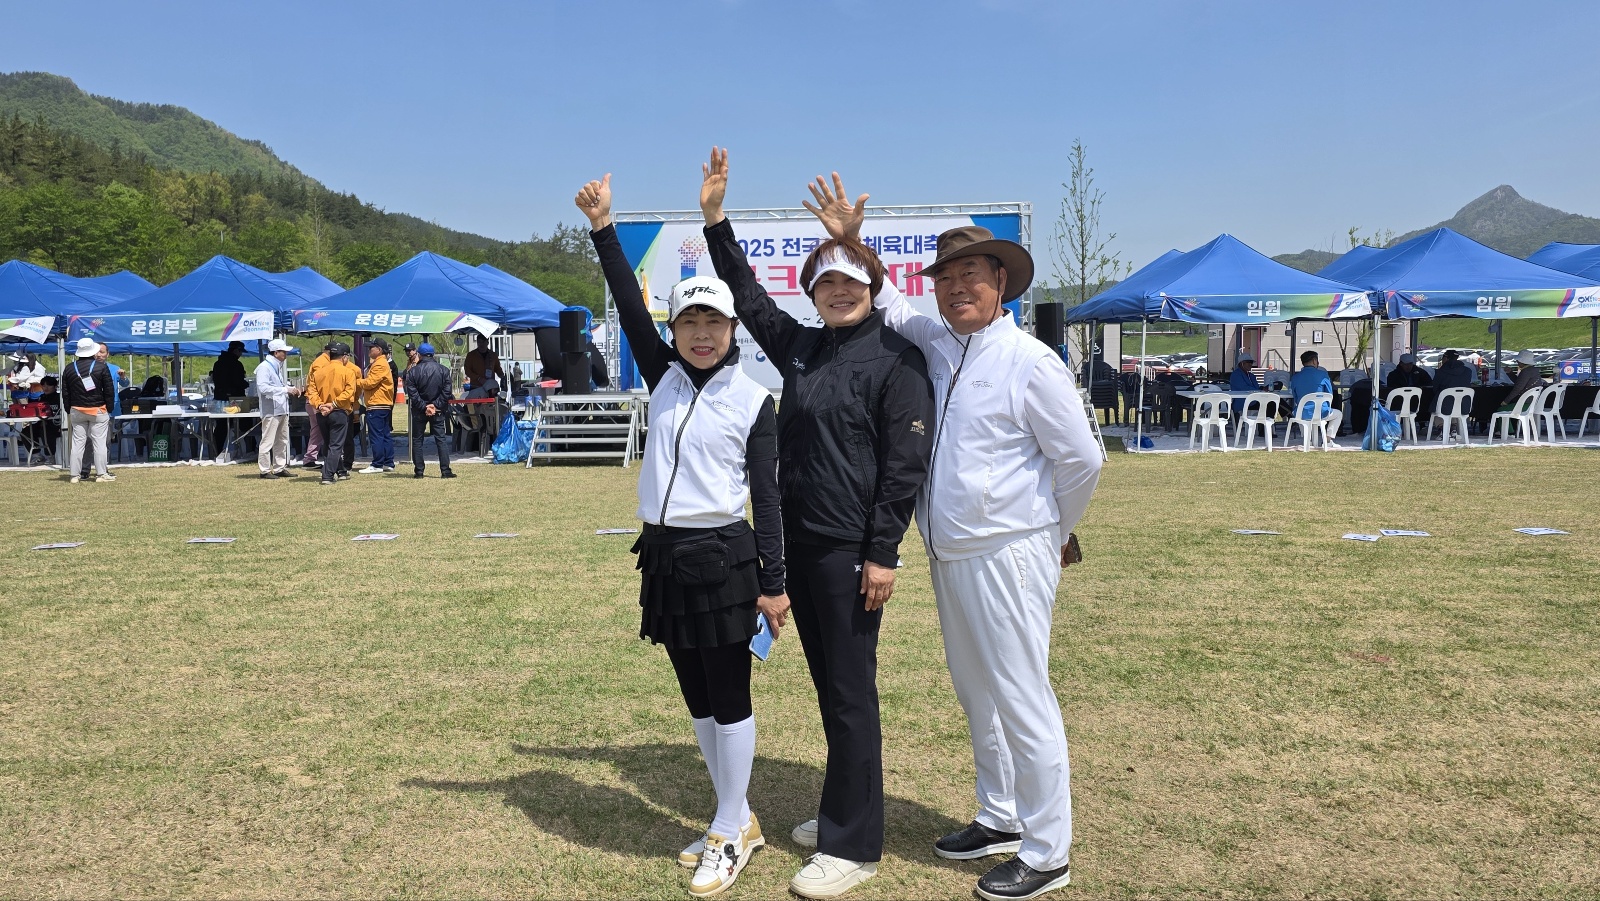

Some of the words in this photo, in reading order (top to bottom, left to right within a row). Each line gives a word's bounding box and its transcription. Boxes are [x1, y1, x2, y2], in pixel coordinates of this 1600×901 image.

[737, 238, 776, 257] 025
[1247, 300, 1281, 317] 임원
[1476, 295, 1512, 313] 임원
[131, 318, 198, 336] 운영본부
[354, 313, 424, 328] 운영본부
